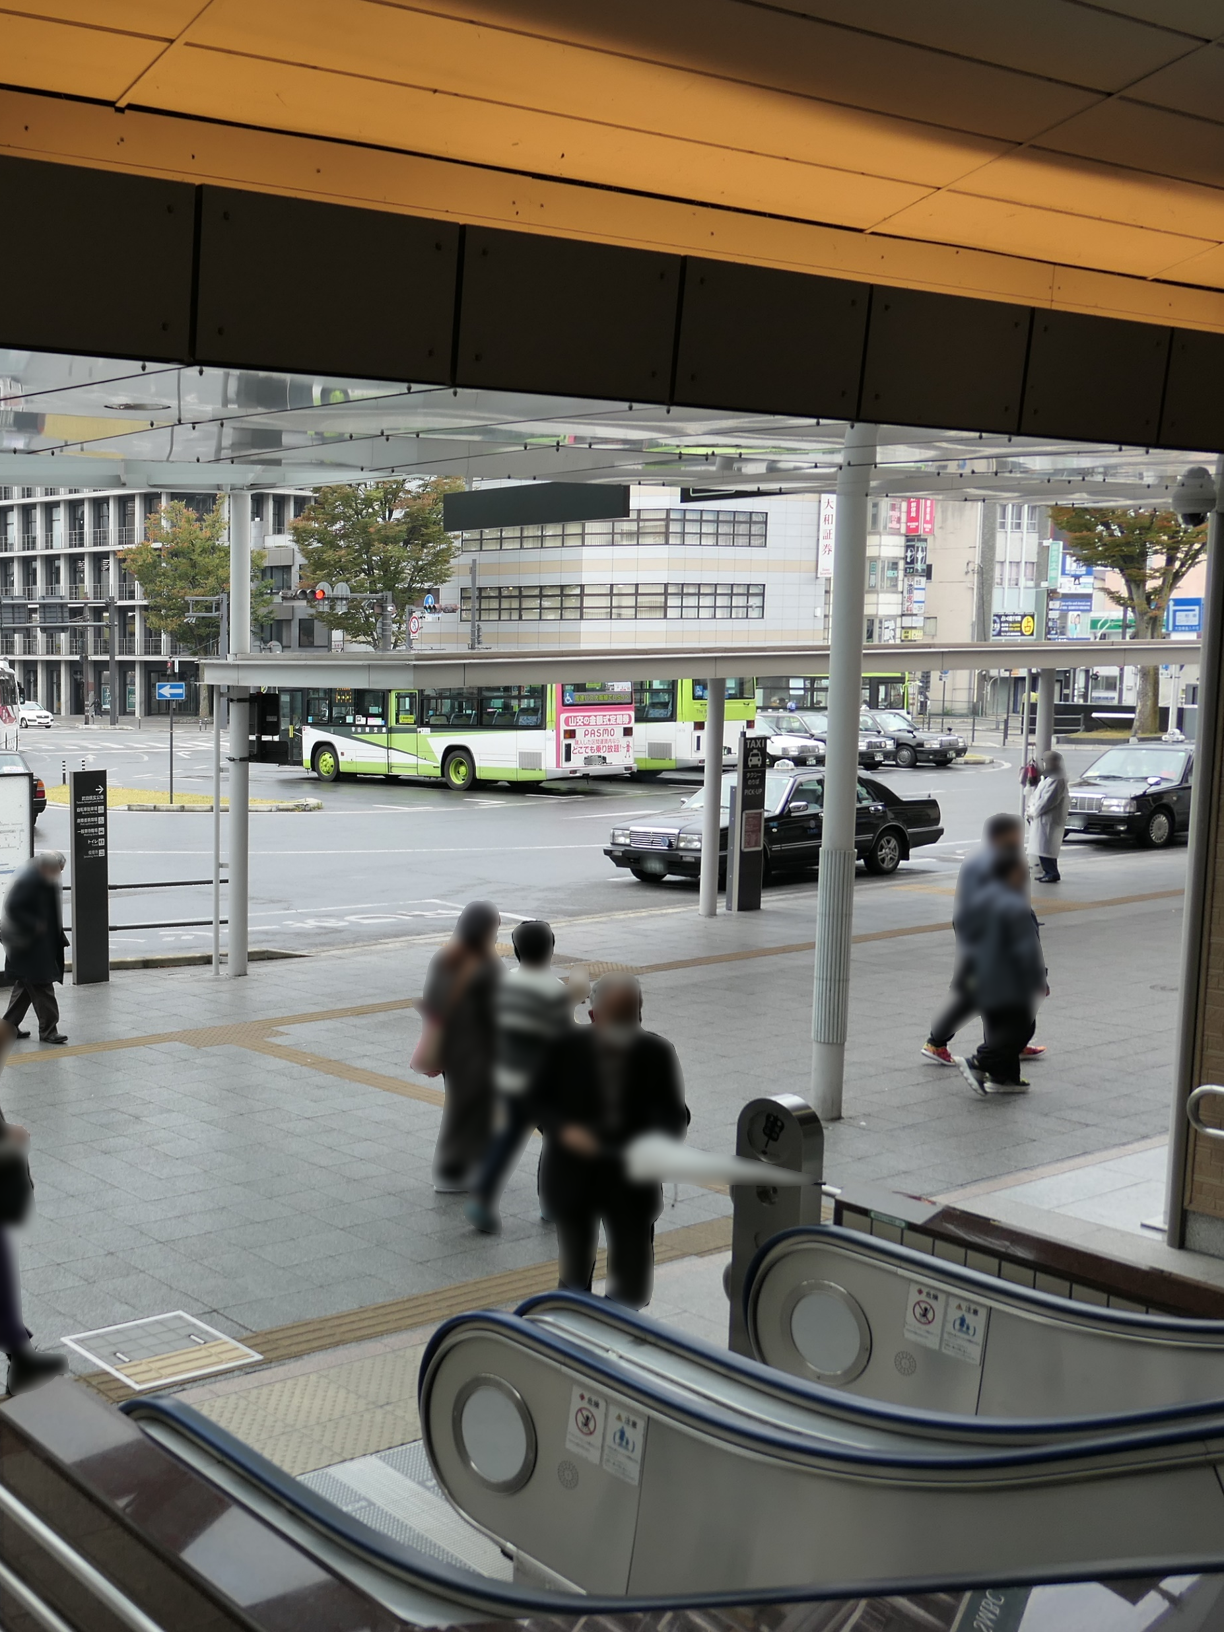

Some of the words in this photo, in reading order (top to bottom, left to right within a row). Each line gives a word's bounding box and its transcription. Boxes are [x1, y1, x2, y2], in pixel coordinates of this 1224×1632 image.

[822, 498, 833, 556] 大和証券
[1025, 617, 1032, 633] 占
[568, 714, 630, 727] 山交の金額式定期券
[583, 728, 616, 738] PASMO
[746, 739, 765, 748] TAXI
[744, 788, 763, 796] PICK-UP
